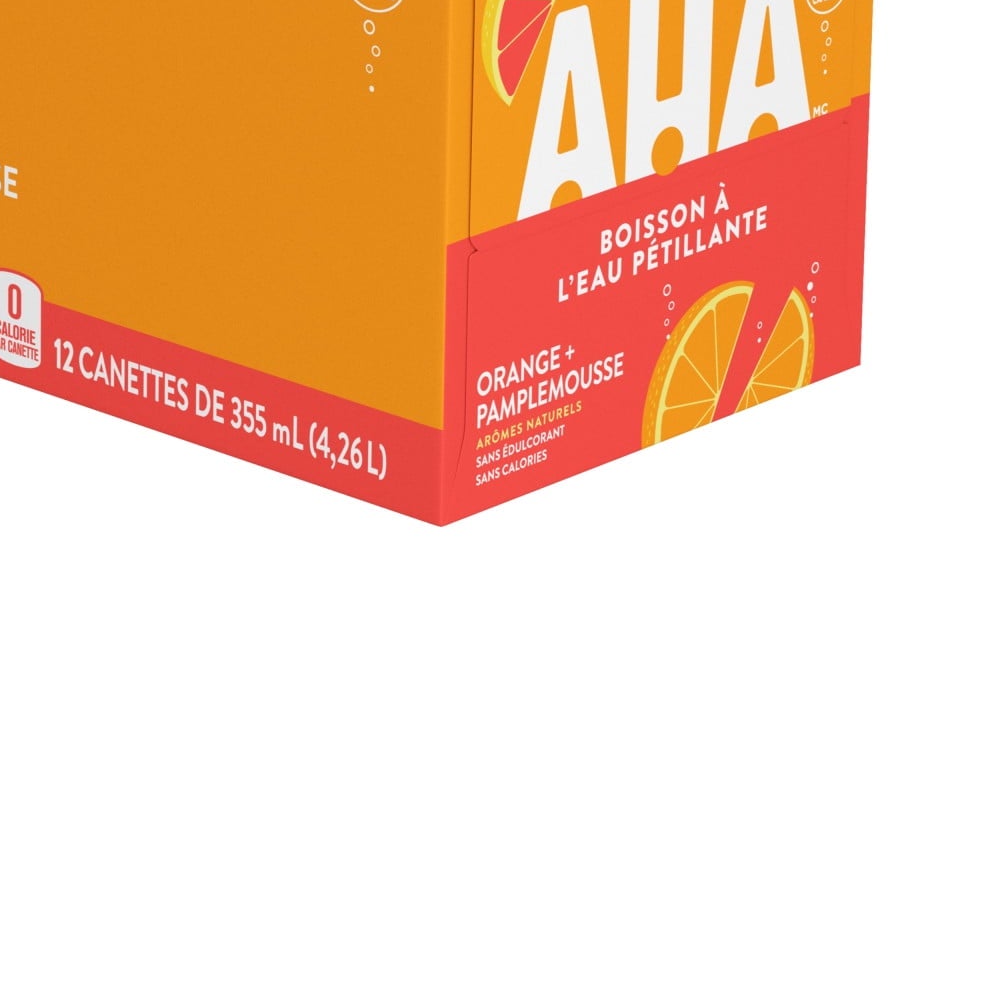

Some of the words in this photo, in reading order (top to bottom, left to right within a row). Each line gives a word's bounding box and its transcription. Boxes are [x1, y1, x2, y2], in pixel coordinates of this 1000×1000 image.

[812, 102, 829, 119] MC
[600, 195, 706, 255] BOISSON
[713, 182, 729, 215] À
[558, 257, 623, 303] L'EAU
[632, 205, 768, 276] PÉTILLANTE
[7, 283, 22, 320] 0
[7, 340, 39, 362] CANETTE
[476, 344, 561, 397] ORANGE
[565, 345, 575, 360] +
[53, 337, 74, 374] 12
[78, 345, 189, 412] CANETTES
[195, 383, 225, 424] DE
[230, 396, 267, 438] 355
[272, 415, 304, 450] mL
[476, 351, 625, 429] PAMPLEMOUSSE
[475, 422, 523, 451] ARÔMES
[526, 400, 582, 431] NATURELS
[475, 449, 501, 469] SANS
[502, 424, 566, 459] ÉDULCORANT
[475, 467, 501, 487] SANS
[501, 449, 548, 476] CALORIES
